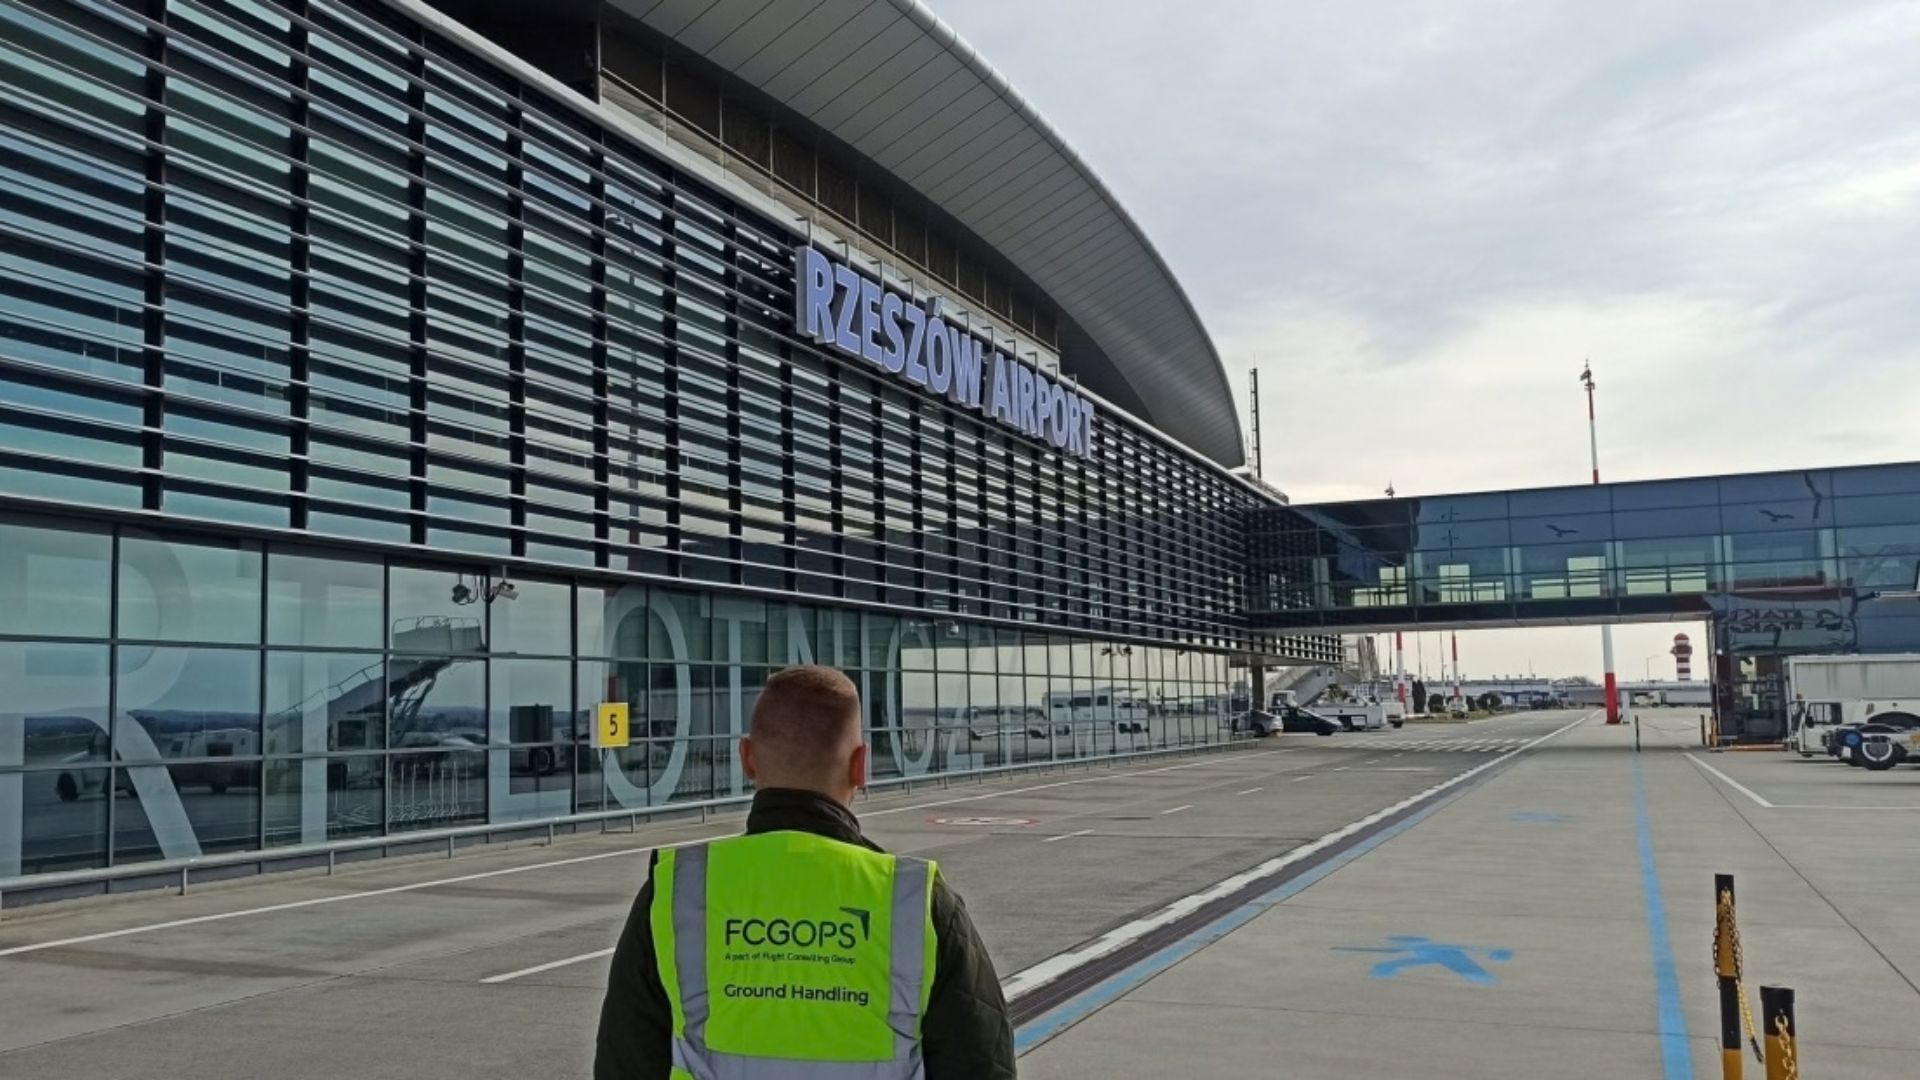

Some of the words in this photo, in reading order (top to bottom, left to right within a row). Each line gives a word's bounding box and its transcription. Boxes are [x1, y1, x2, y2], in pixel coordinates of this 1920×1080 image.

[797, 245, 983, 409] RZESZÓW
[985, 352, 1095, 459] AIRPORT
[609, 713, 618, 737] 5
[725, 918, 857, 949] FCGOPS
[725, 953, 732, 961] A
[732, 954, 750, 963] part
[751, 952, 761, 961] of
[763, 952, 785, 963] Flight
[831, 954, 856, 965] Group
[724, 983, 787, 999] Ground
[791, 984, 869, 1006] Handling
